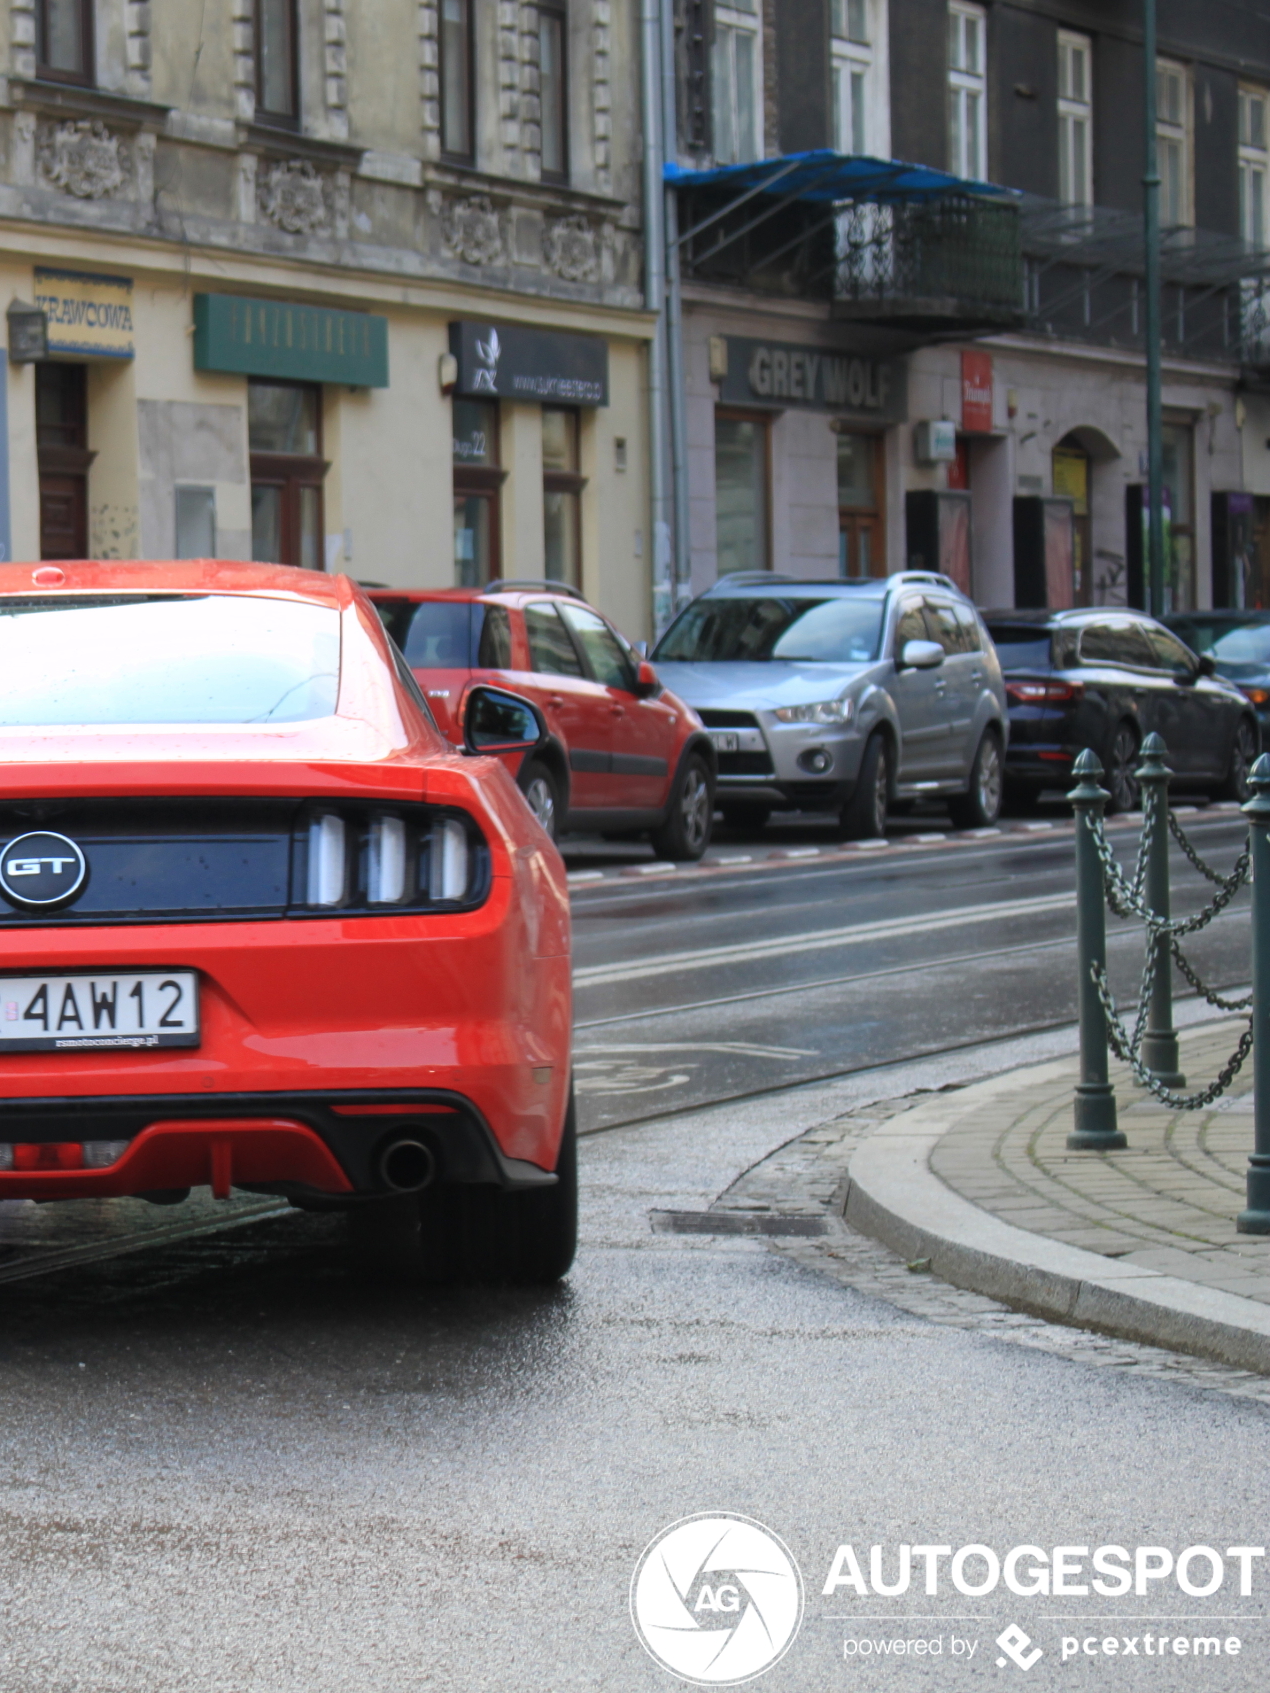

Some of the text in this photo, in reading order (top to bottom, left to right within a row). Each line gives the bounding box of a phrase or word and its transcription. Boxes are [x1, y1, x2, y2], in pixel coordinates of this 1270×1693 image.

[749, 347, 894, 408] GREY WOLF
[472, 430, 486, 455] 22
[7, 857, 75, 876] GT
[23, 980, 185, 1031] 4AW12
